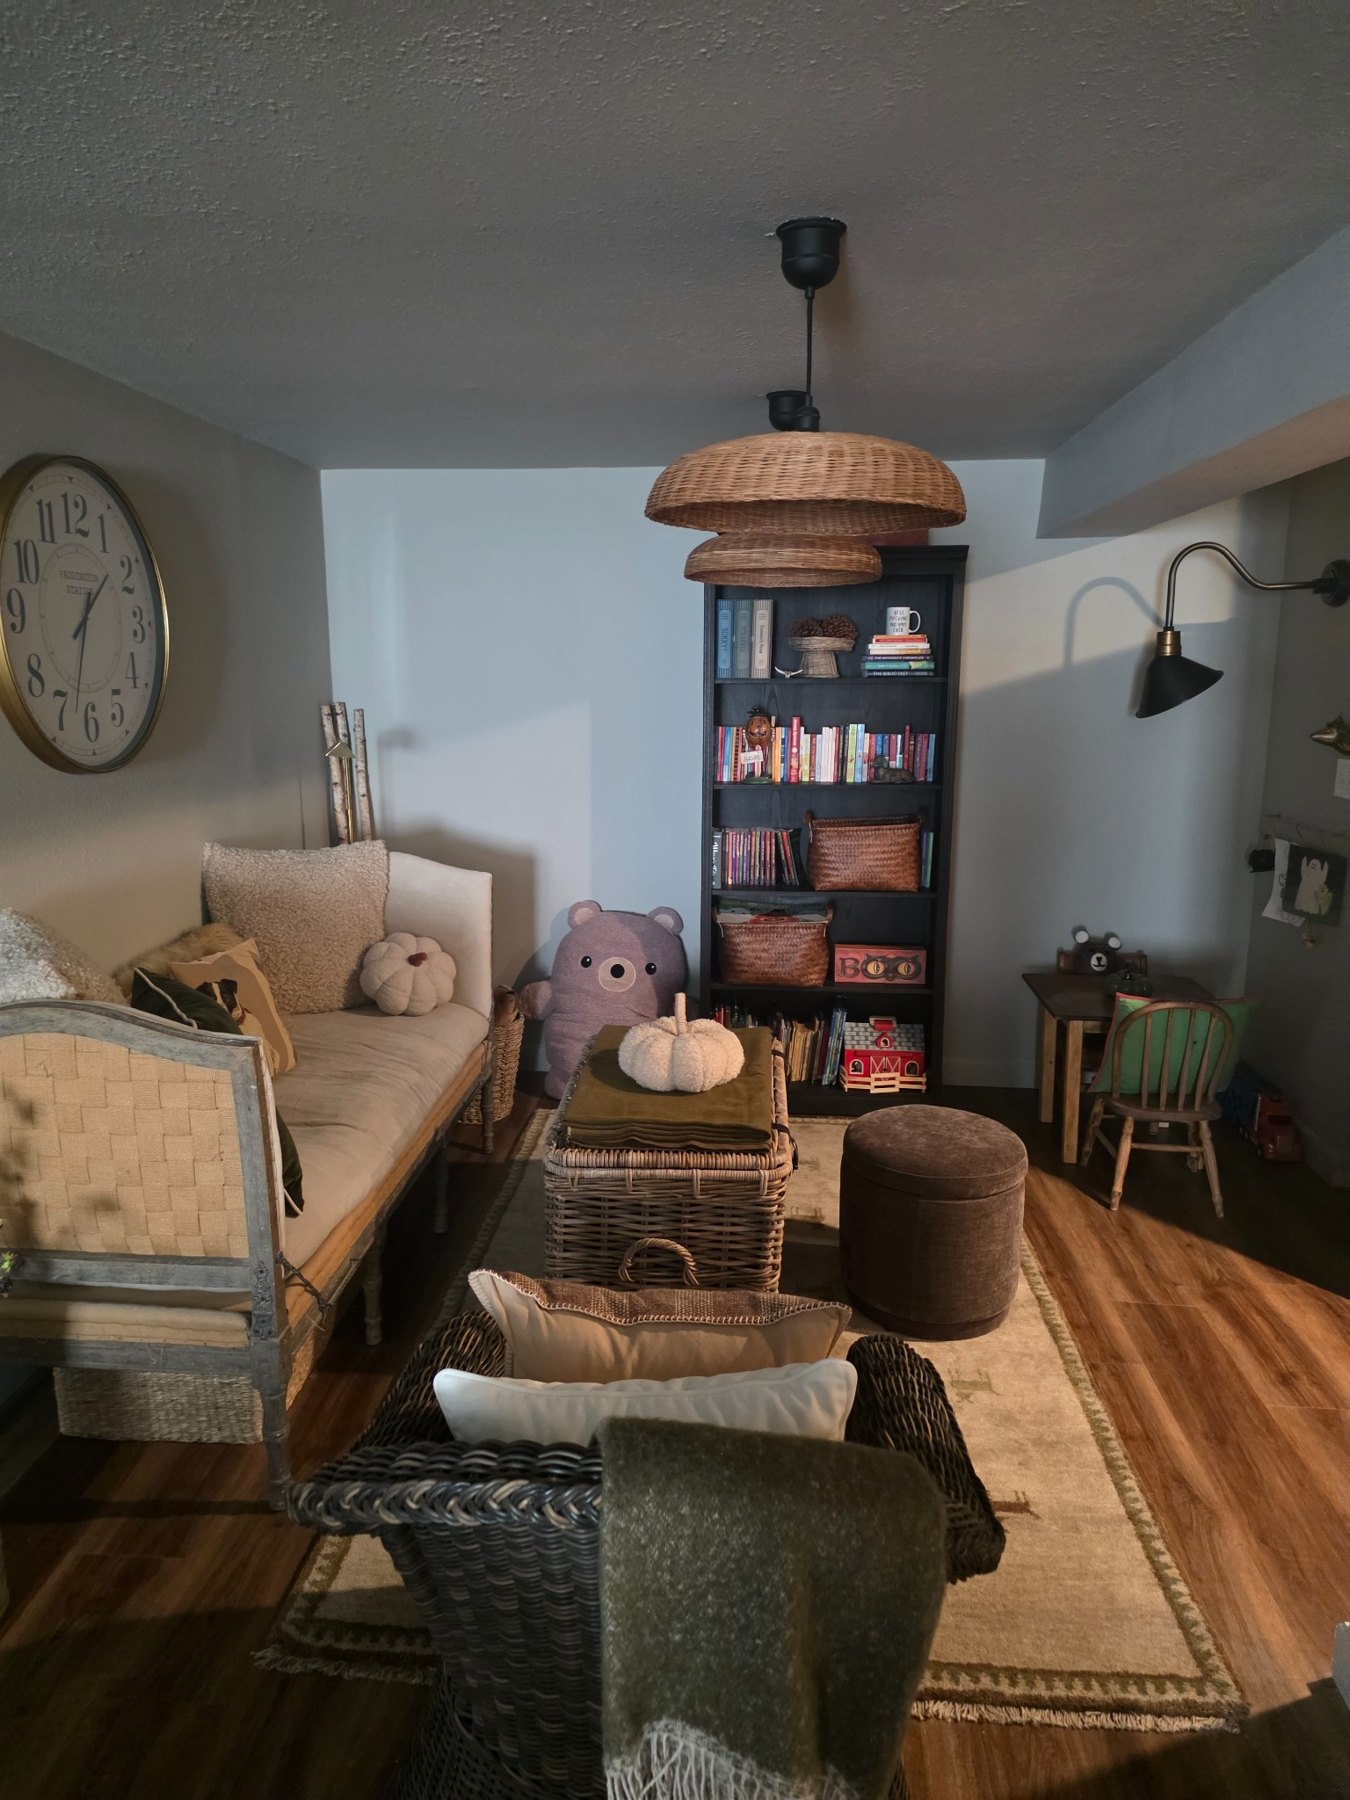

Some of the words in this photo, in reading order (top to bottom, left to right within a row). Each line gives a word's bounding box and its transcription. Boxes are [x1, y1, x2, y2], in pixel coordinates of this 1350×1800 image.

[36, 498, 57, 544] 11
[61, 492, 90, 538] 12
[97, 513, 109, 553] 1
[13, 539, 40, 584] 10
[119, 554, 136, 595] 2
[6, 588, 26, 634] 9
[132, 605, 146, 644] 3
[27, 653, 45, 698] 8
[125, 651, 139, 689] 4
[53, 689, 68, 731] 7
[83, 701, 99, 743] 6
[111, 688, 125, 728] 5
